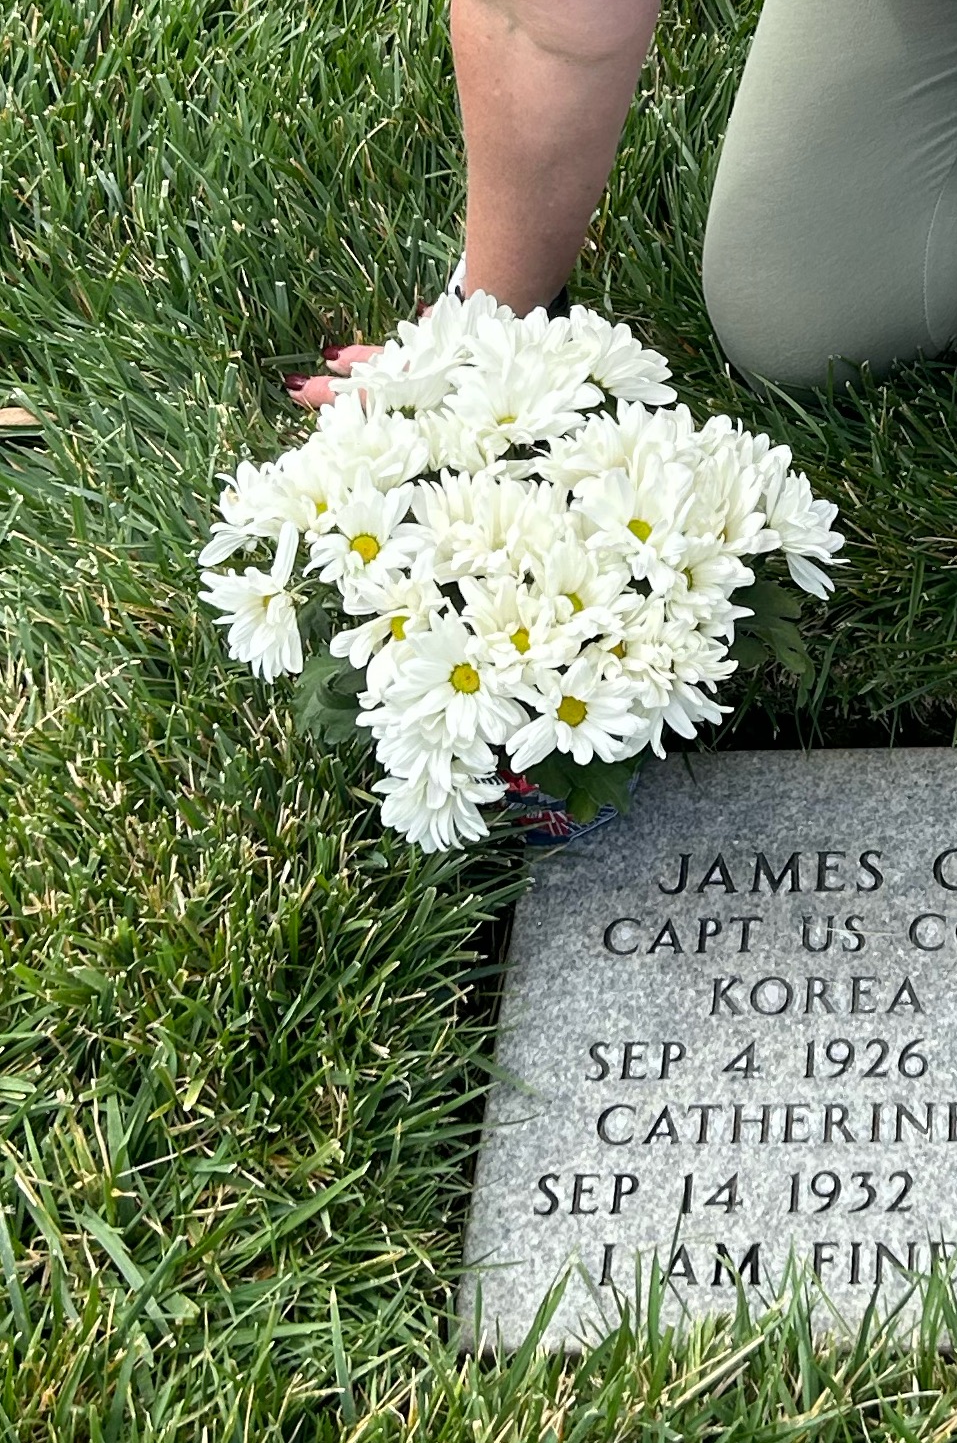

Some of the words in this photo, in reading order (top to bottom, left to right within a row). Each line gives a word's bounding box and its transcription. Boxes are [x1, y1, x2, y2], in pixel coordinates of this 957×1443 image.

[658, 849, 885, 895] JAMES
[603, 916, 764, 955] CAPT
[800, 914, 866, 953] US
[709, 975, 926, 1016] KOREA
[585, 1040, 687, 1082] SEP
[721, 1040, 761, 1079] 4
[804, 1037, 929, 1079] 1926
[533, 1172, 640, 1216] SEP
[681, 1171, 743, 1214] 14
[787, 1170, 914, 1214] 1932
[598, 1243, 615, 1286] I
[660, 1242, 761, 1286] AM
